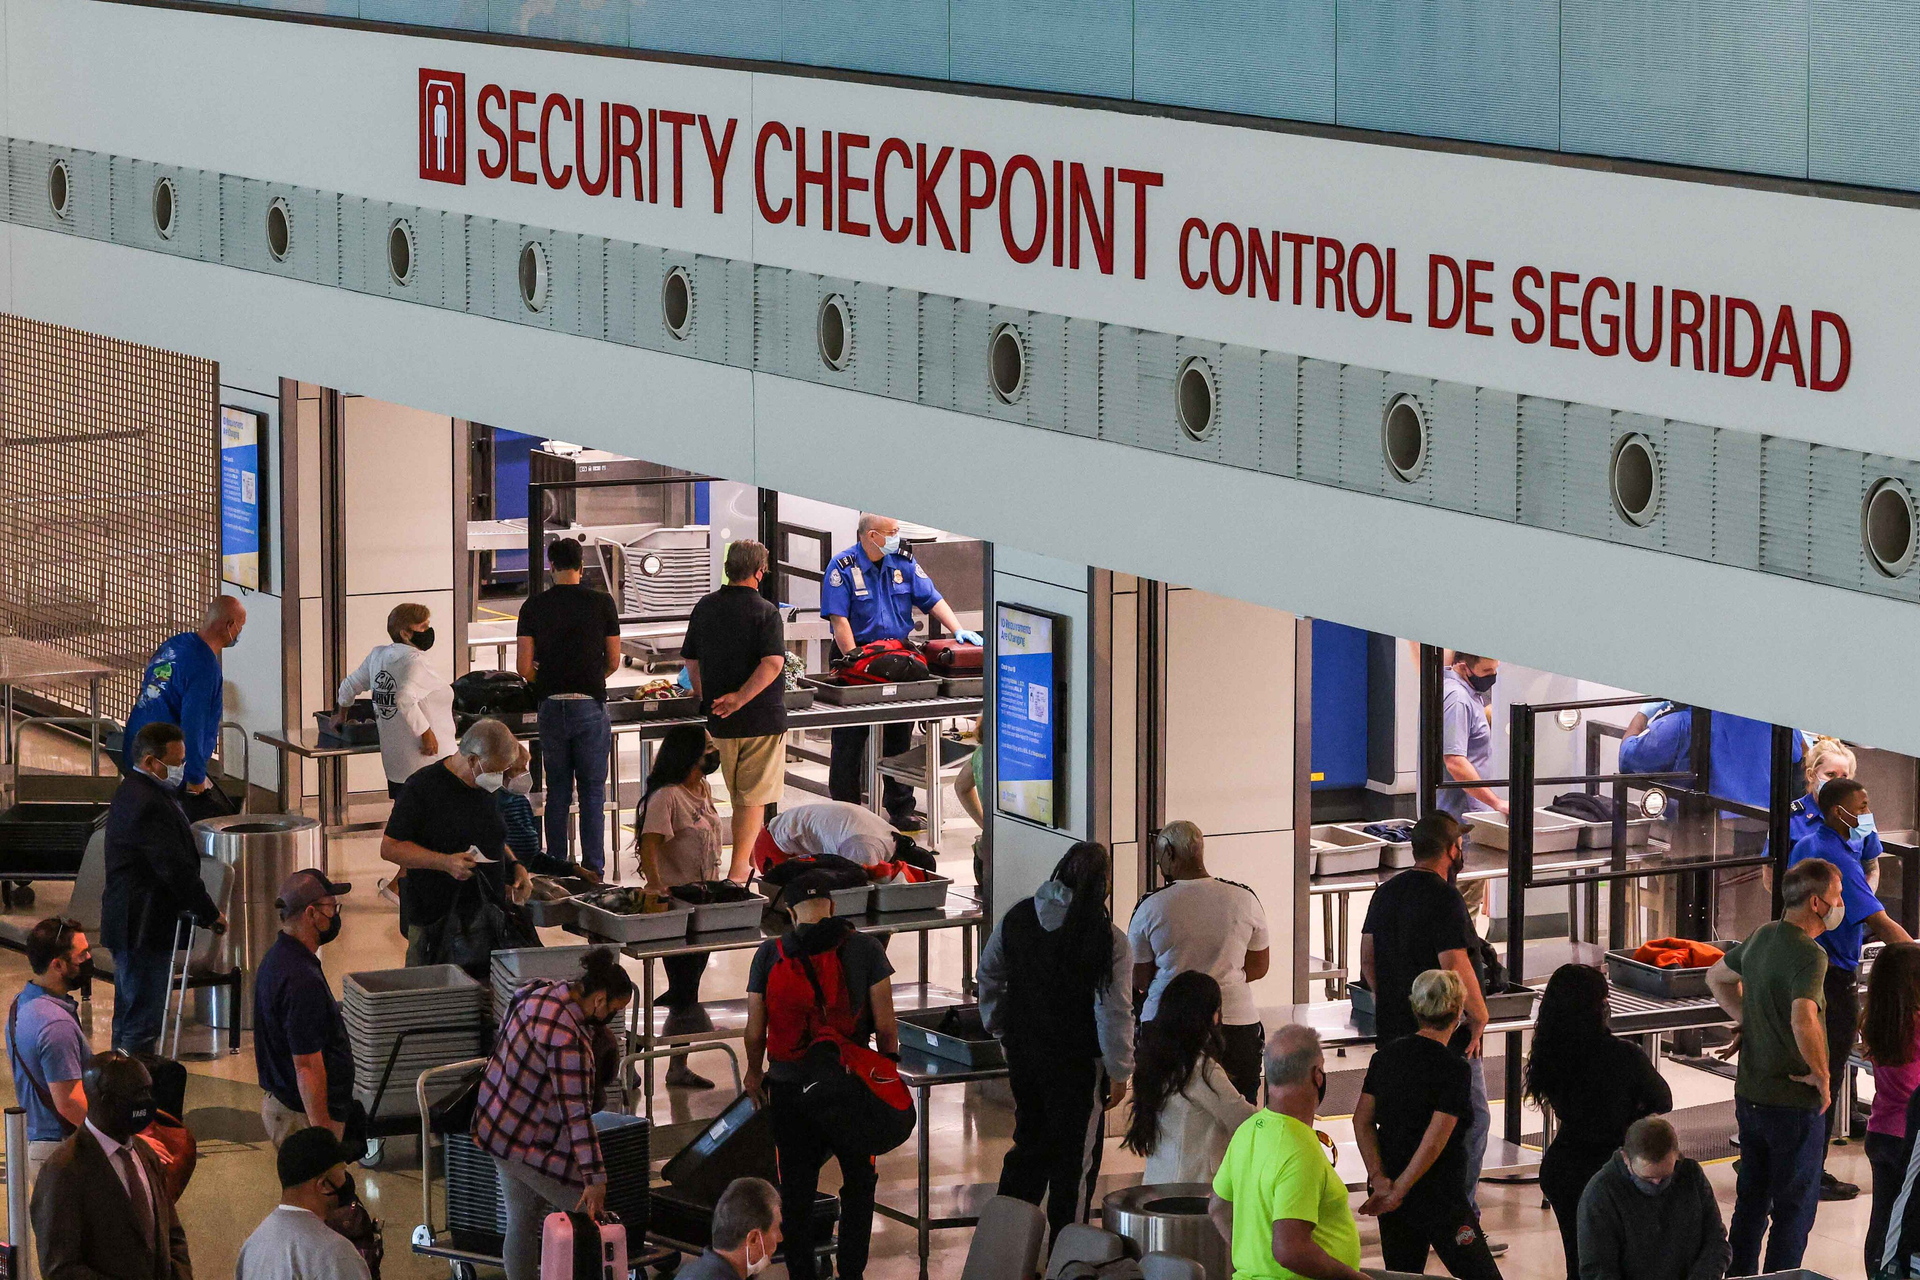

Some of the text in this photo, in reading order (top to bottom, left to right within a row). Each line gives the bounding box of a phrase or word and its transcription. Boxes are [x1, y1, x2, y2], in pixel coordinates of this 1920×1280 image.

[477, 84, 1163, 280] SECURITY CHECKPOINT
[1179, 217, 1851, 392] CONTROL DE SEGURIDAD
